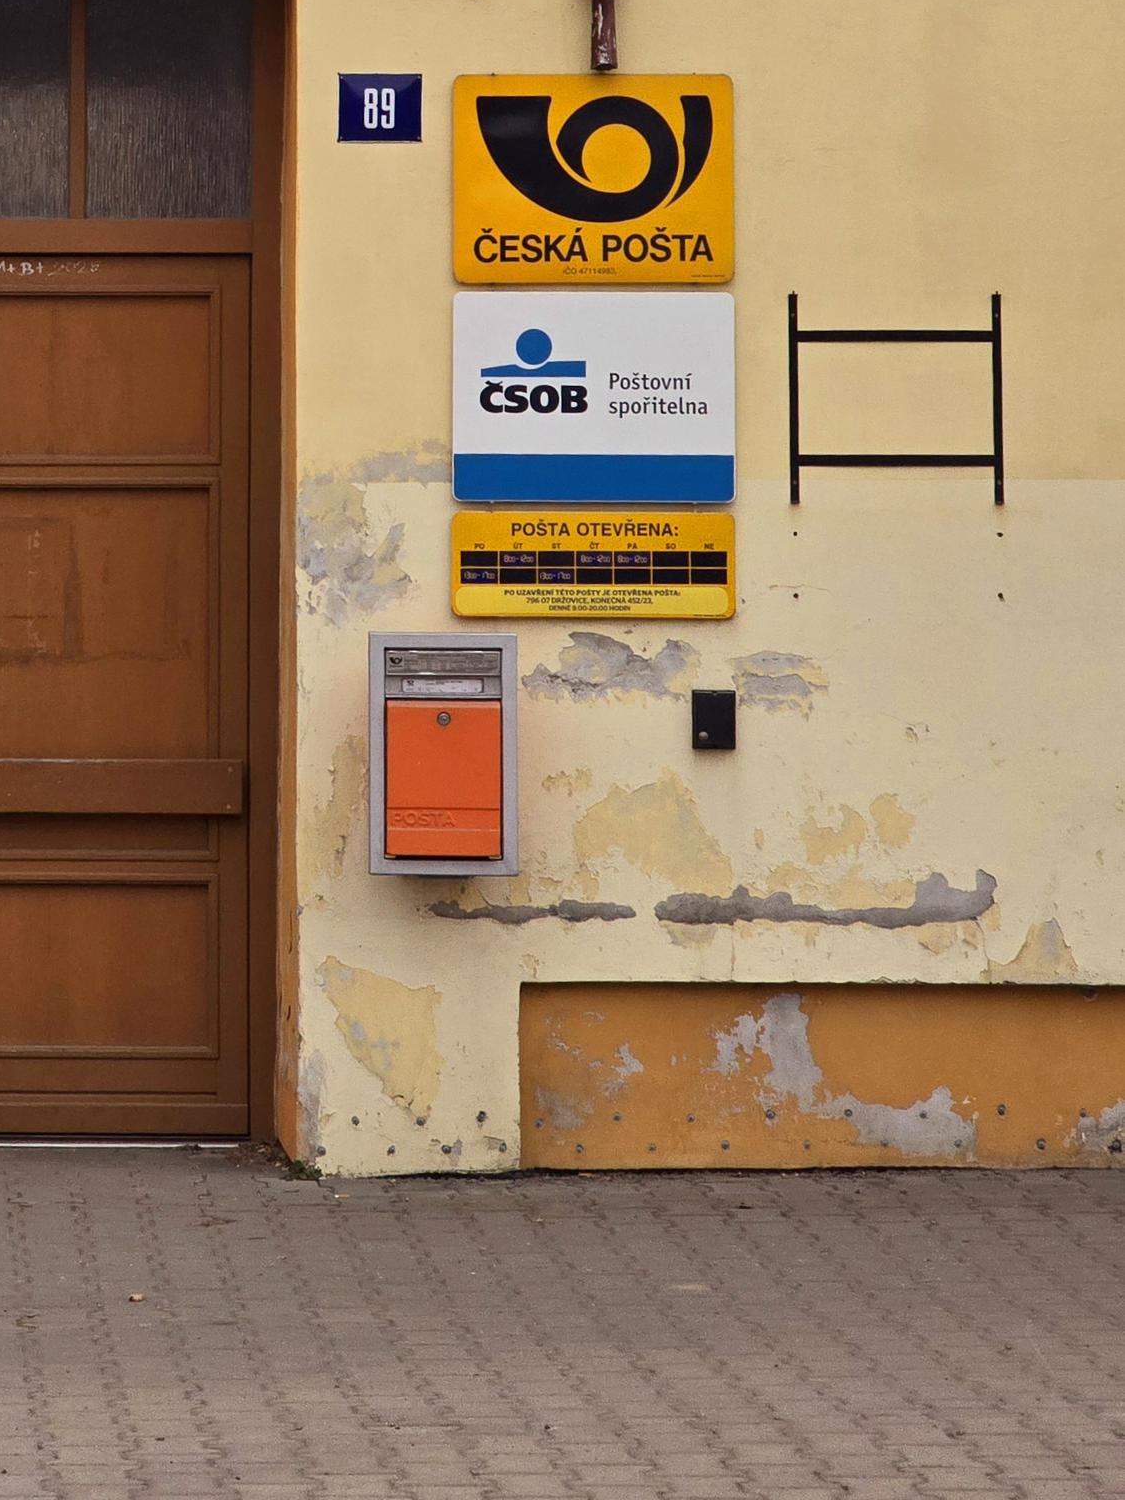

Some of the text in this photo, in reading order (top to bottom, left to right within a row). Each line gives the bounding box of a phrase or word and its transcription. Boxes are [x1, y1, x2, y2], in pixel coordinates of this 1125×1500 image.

[363, 87, 396, 130] 89
[474, 227, 714, 263] ČESKÁ POŠTA
[608, 372, 693, 391] Poštovní
[479, 380, 588, 414] ČSOB
[608, 397, 708, 419] spořitelna
[511, 519, 680, 537] POŠTA OTEVŘENA:
[655, 589, 681, 597] POŠTA:
